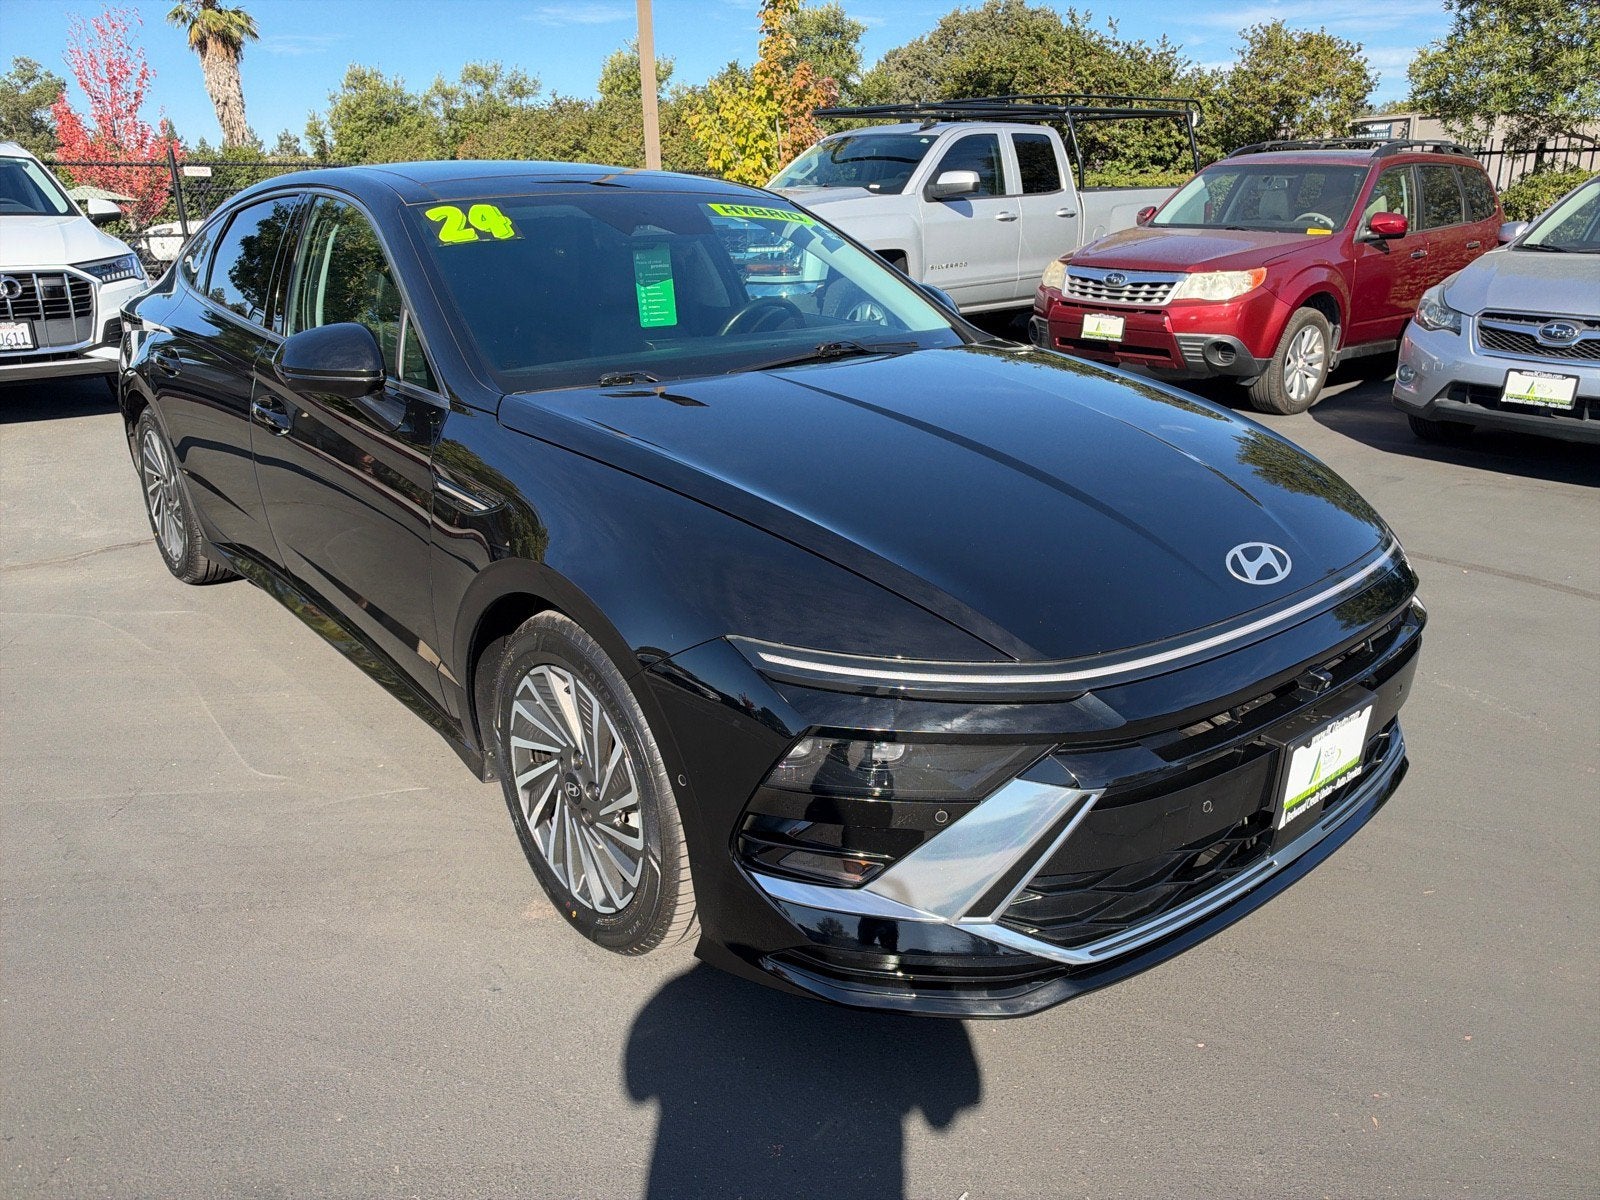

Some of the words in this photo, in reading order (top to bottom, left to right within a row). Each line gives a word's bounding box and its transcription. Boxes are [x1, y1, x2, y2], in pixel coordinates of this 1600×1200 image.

[719, 205, 804, 222] HYBRID
[425, 204, 515, 243] 24
[930, 261, 968, 271] SILVERADO
